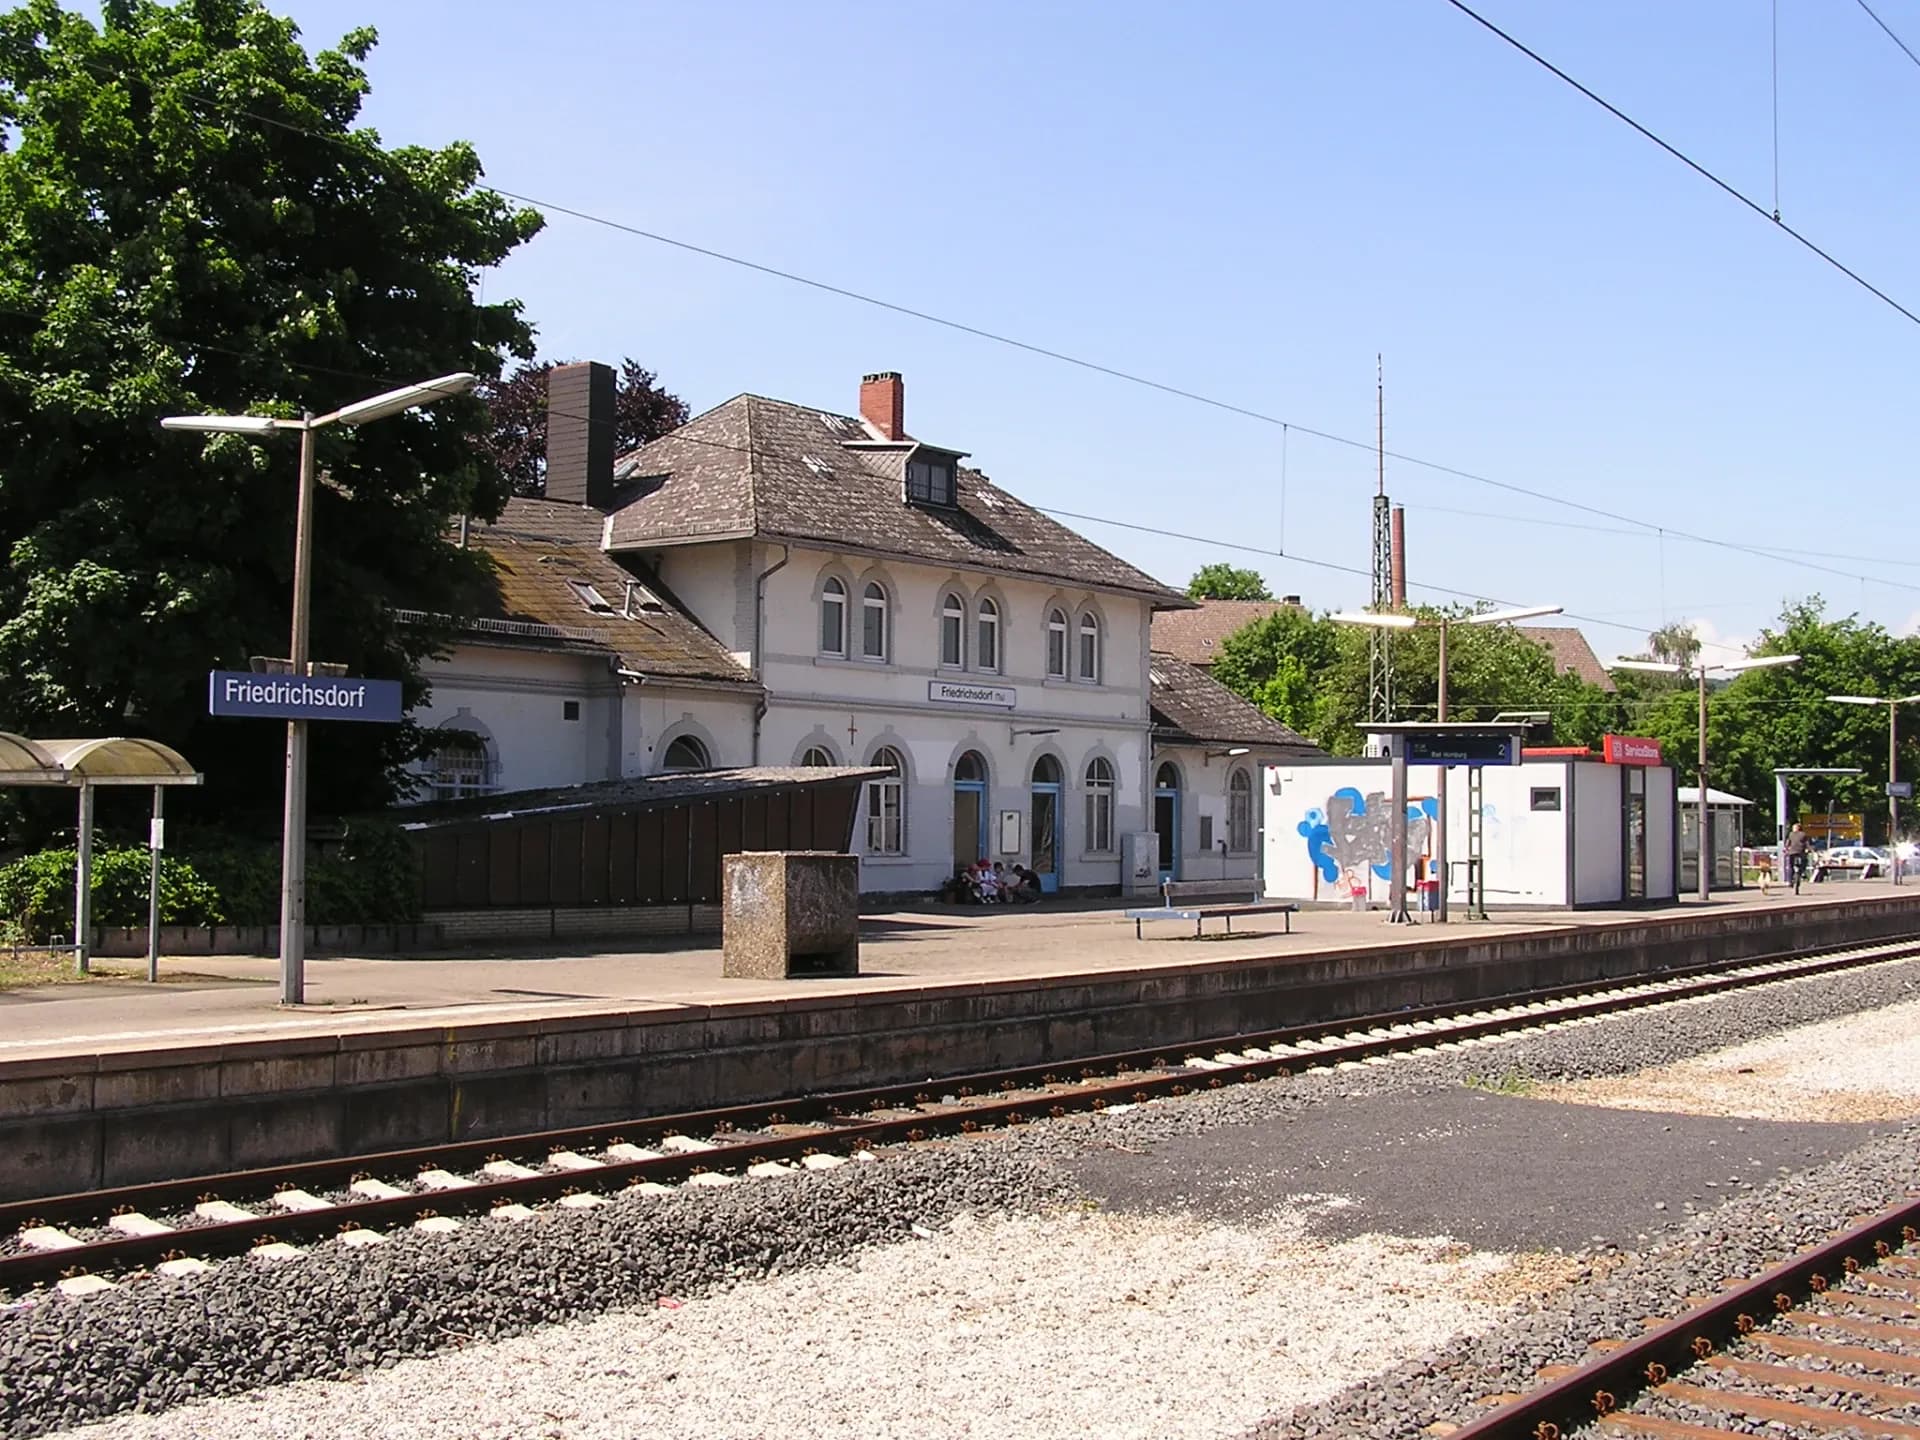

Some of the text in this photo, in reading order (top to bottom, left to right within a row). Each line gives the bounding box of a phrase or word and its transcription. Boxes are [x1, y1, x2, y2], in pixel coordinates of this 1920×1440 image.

[225, 679, 365, 708] Friedrichsdorf
[941, 686, 993, 701] Friedrichsdorf
[1498, 744, 1506, 756] 2
